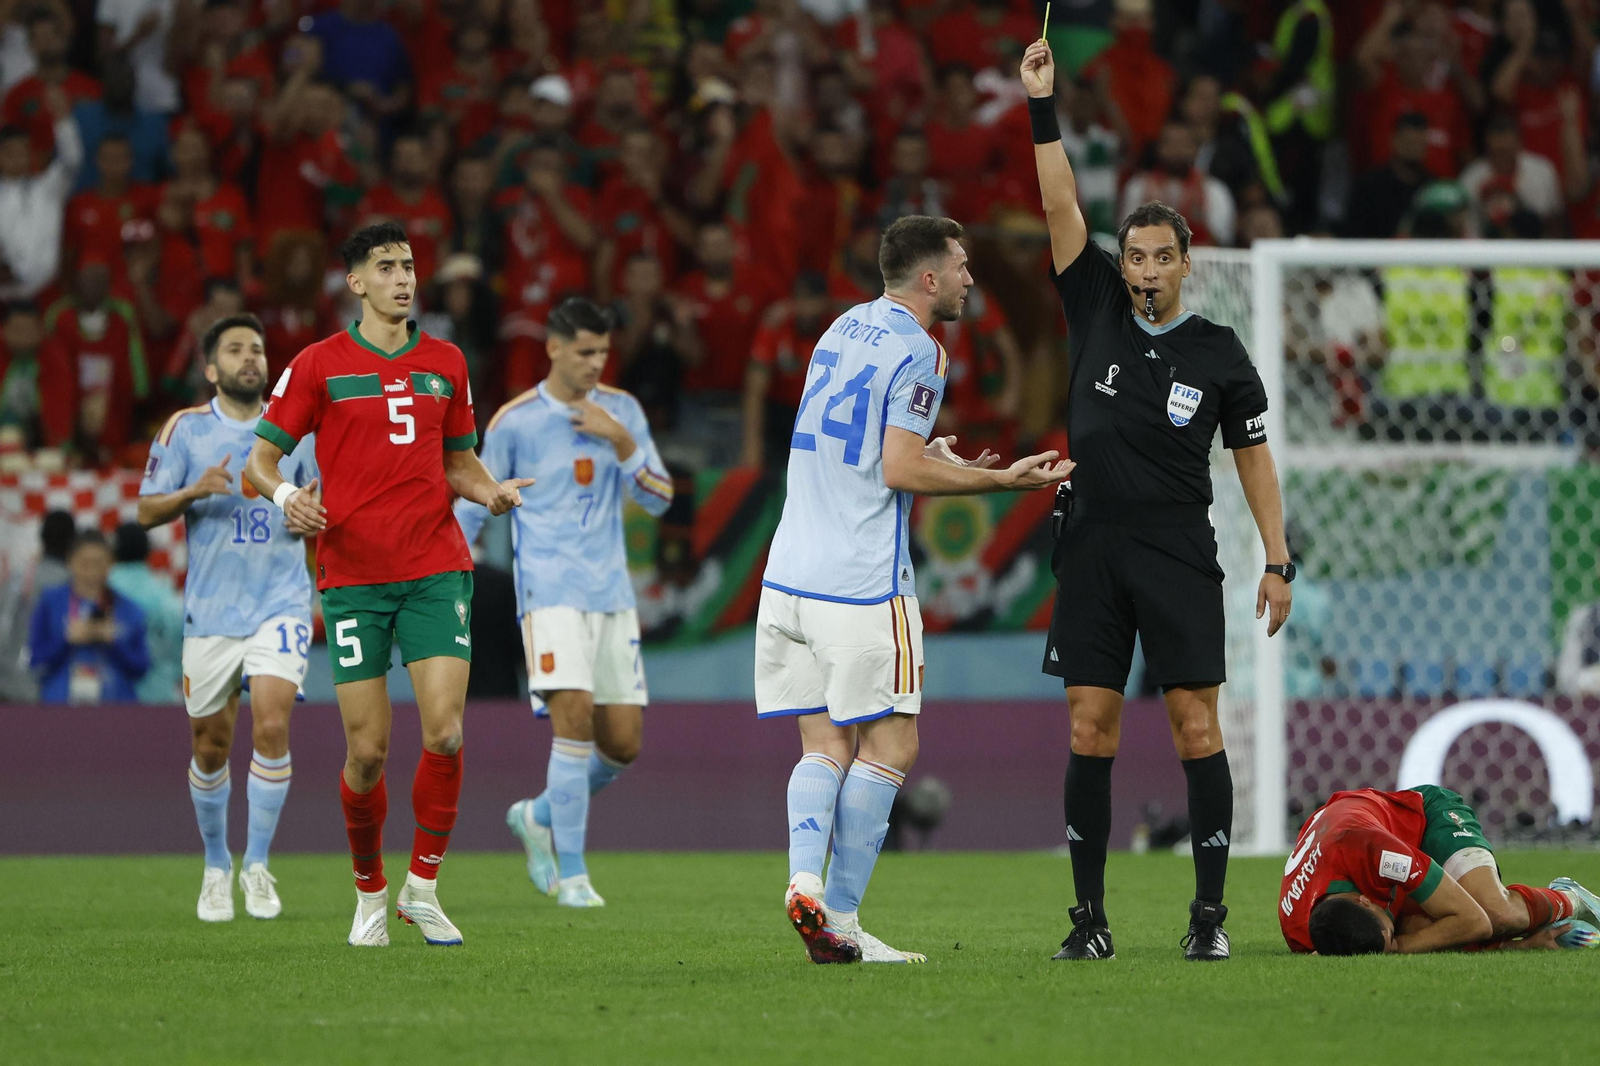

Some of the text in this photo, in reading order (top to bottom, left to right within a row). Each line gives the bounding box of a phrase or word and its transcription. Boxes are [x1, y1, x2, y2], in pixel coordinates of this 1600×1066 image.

[832, 316, 890, 347] LAPORTE
[790, 349, 879, 467] 24
[1170, 400, 1196, 413] REFEREE
[1173, 385, 1199, 402] FIFA
[386, 396, 416, 445] 5
[1172, 415, 1186, 424] 2022
[230, 507, 271, 544] 18
[577, 494, 594, 528] 7
[276, 622, 309, 660] 18
[335, 618, 364, 668] 5
[1281, 841, 1322, 917] HAKIMI
